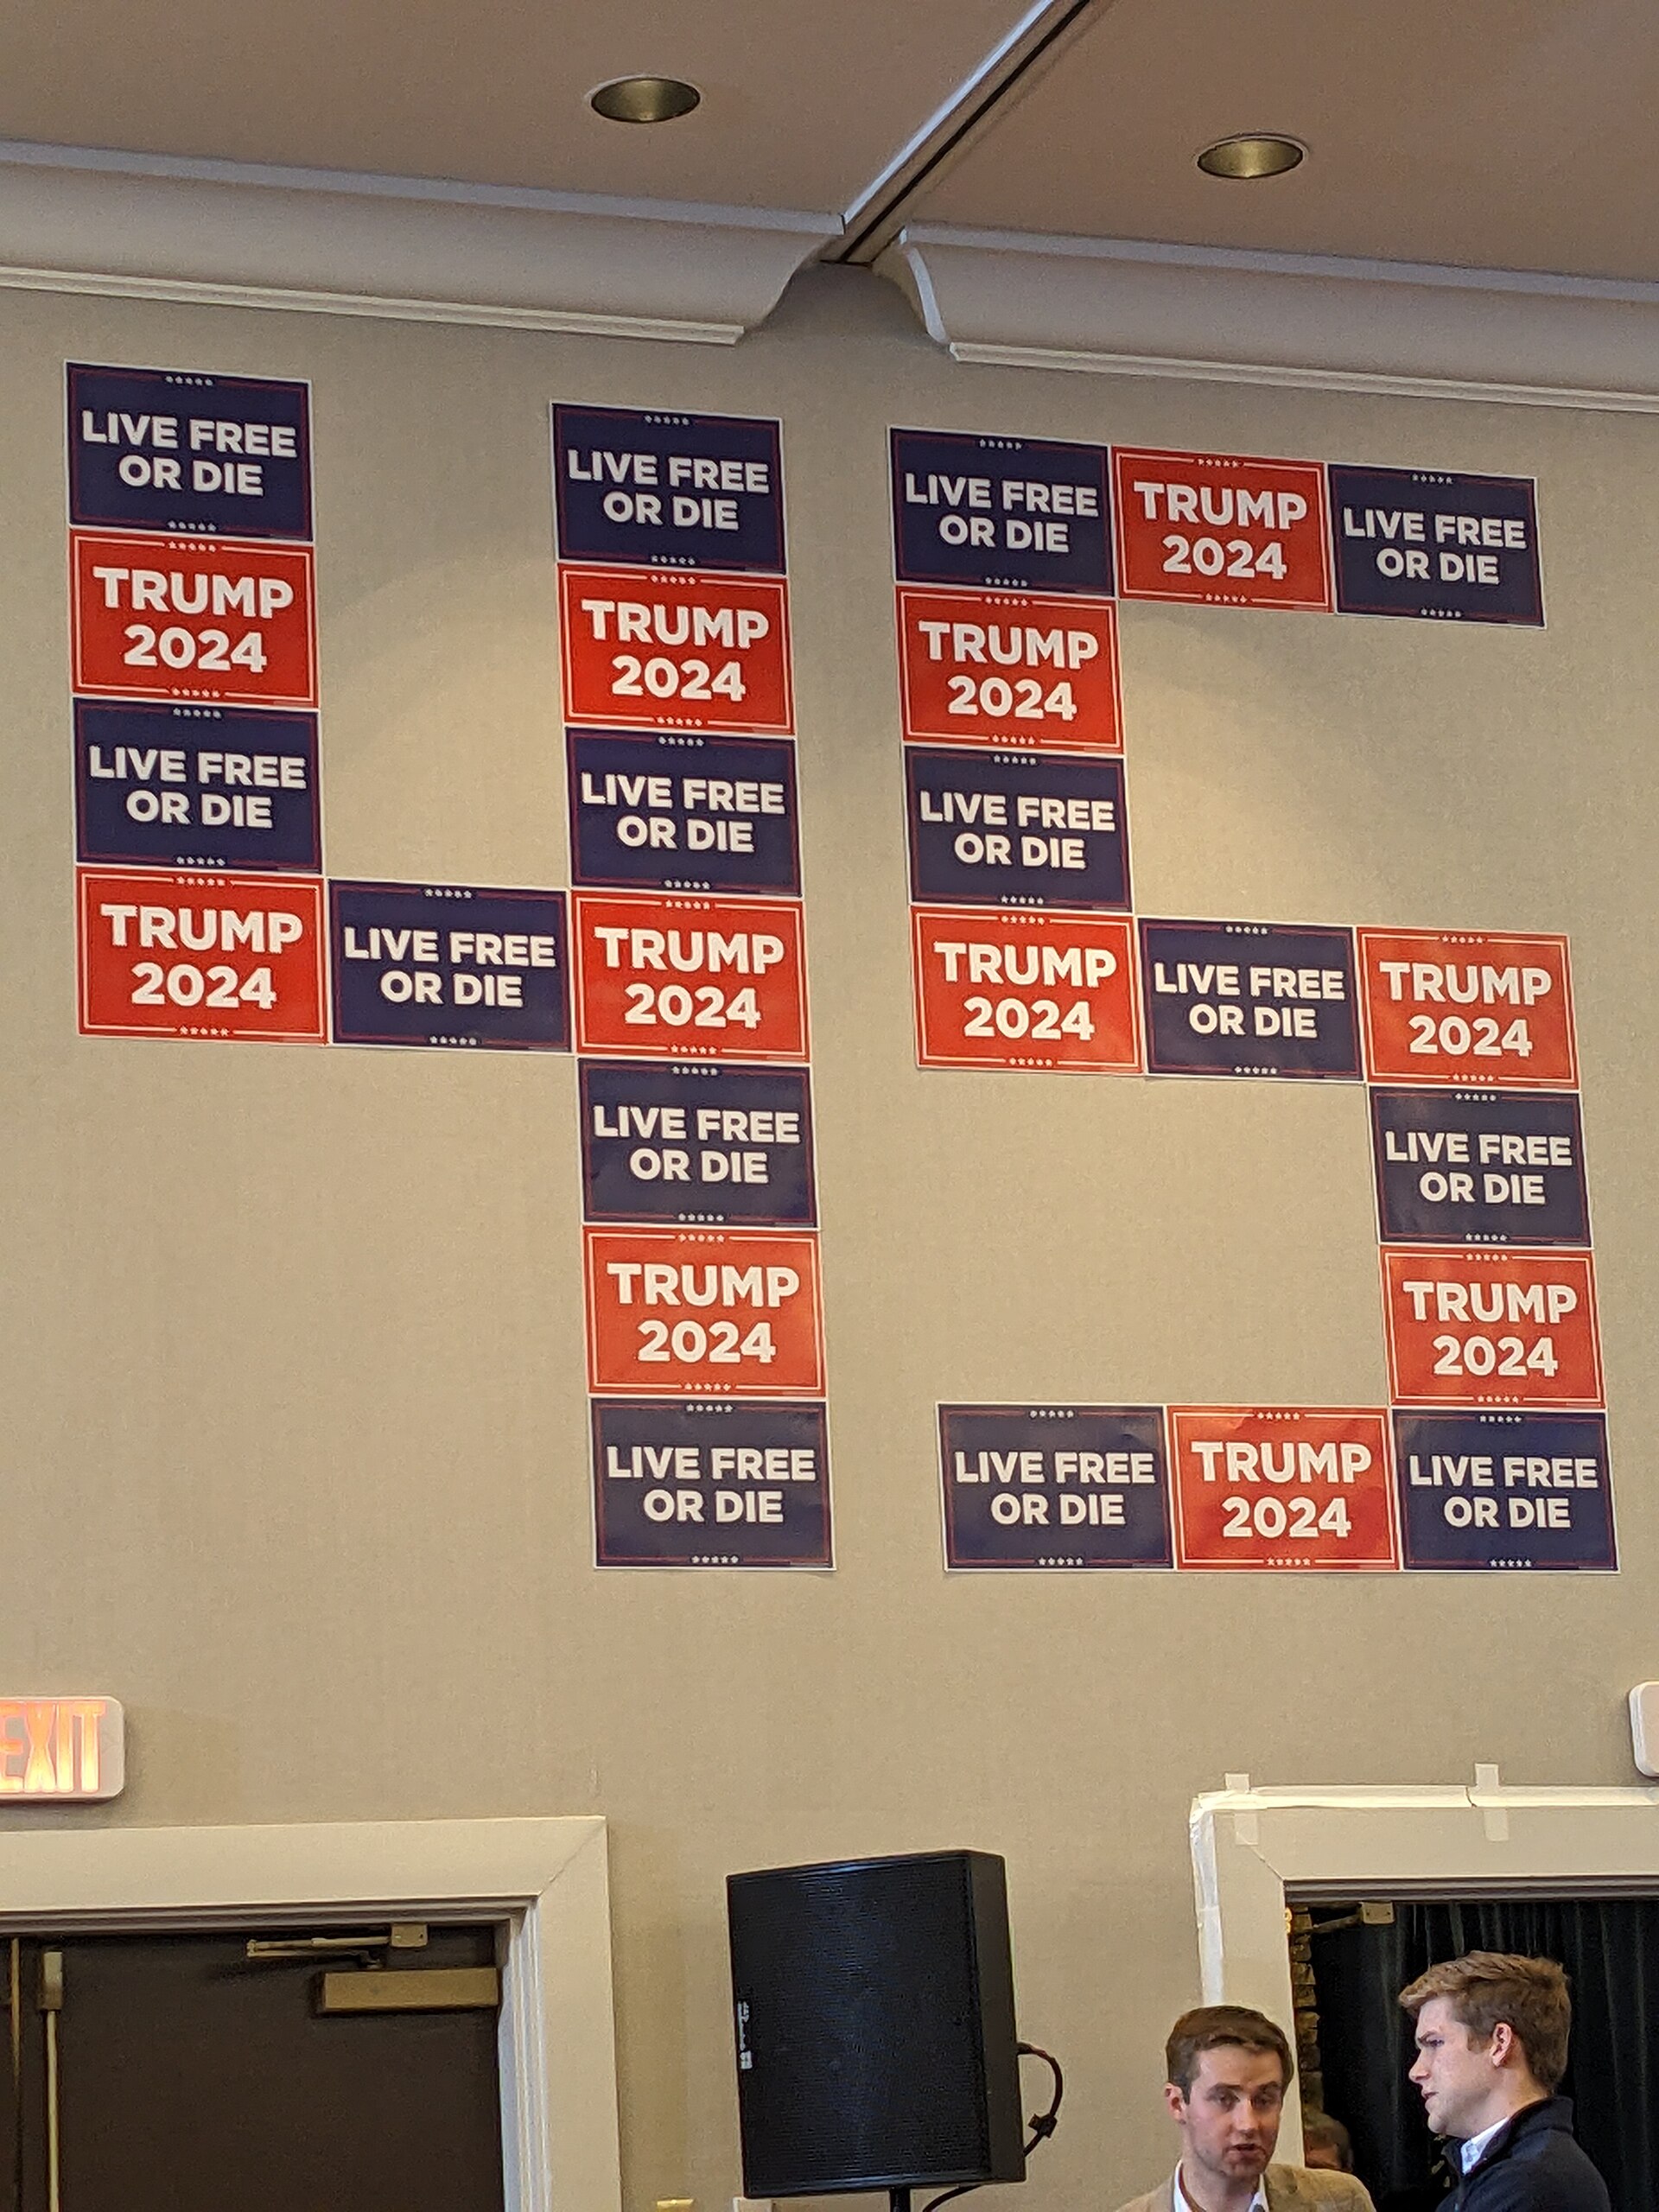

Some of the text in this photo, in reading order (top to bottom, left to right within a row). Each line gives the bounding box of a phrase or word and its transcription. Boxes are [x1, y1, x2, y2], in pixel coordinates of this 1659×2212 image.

[82, 410, 297, 458] LIVE FREE
[118, 454, 264, 495] OR DIE
[568, 449, 769, 493] LIVE FREE
[603, 492, 739, 530] OR DIE
[906, 473, 1099, 517] LIVE FREE
[1134, 481, 1307, 530] TRUMP
[939, 515, 1069, 553] OR DIE
[1344, 507, 1527, 550] LIVE FREE
[1162, 535, 1287, 580] 2024
[1376, 548, 1499, 585] OR DIE
[92, 566, 294, 619] TRUMP
[582, 599, 769, 649] TRUMP
[918, 620, 1098, 670] TRUMP
[124, 624, 267, 673] 2024
[612, 655, 747, 702] 2024
[947, 675, 1077, 721] 2024
[89, 745, 307, 789] LIVE FREE
[126, 790, 272, 829] OR DIE
[582, 772, 785, 815] LIVE FREE
[920, 791, 1116, 832] LIVE FREE
[617, 815, 754, 853] OR DIE
[954, 832, 1086, 870] OR DIE
[100, 903, 303, 954] TRUMP
[344, 926, 556, 968] LIVE FREE
[594, 926, 785, 974] TRUMP
[131, 962, 277, 1009] 2024
[933, 940, 1117, 988] TRUMP
[1154, 962, 1345, 1001] LIVE FREE
[1379, 961, 1552, 1006] TRUMP
[380, 970, 524, 1007] OR DIE
[625, 983, 762, 1029] 2024
[963, 996, 1096, 1041] 2024
[1189, 1003, 1318, 1039] OR DIE
[1408, 1014, 1533, 1058] 2024
[593, 1105, 801, 1144] LIVE FREE
[629, 1147, 769, 1184] OR DIE
[1384, 1130, 1573, 1166] LIVE FREE
[1419, 1172, 1546, 1205] OR DIE
[607, 1262, 800, 1307] TRUMP
[1402, 1281, 1578, 1324] TRUMP
[638, 1319, 776, 1363] 2024
[1433, 1335, 1559, 1377] 2024
[607, 1446, 816, 1481] LIVE FREE
[955, 1451, 1156, 1484] LIVE FREE
[1191, 1440, 1372, 1484] TRUMP
[1409, 1455, 1599, 1489] LIVE FREE
[643, 1489, 784, 1523] OR DIE
[990, 1492, 1126, 1525] OR DIE
[1222, 1496, 1352, 1538] 2024
[1444, 1496, 1571, 1529] OR DIE
[0, 1700, 106, 1793] EXIT
